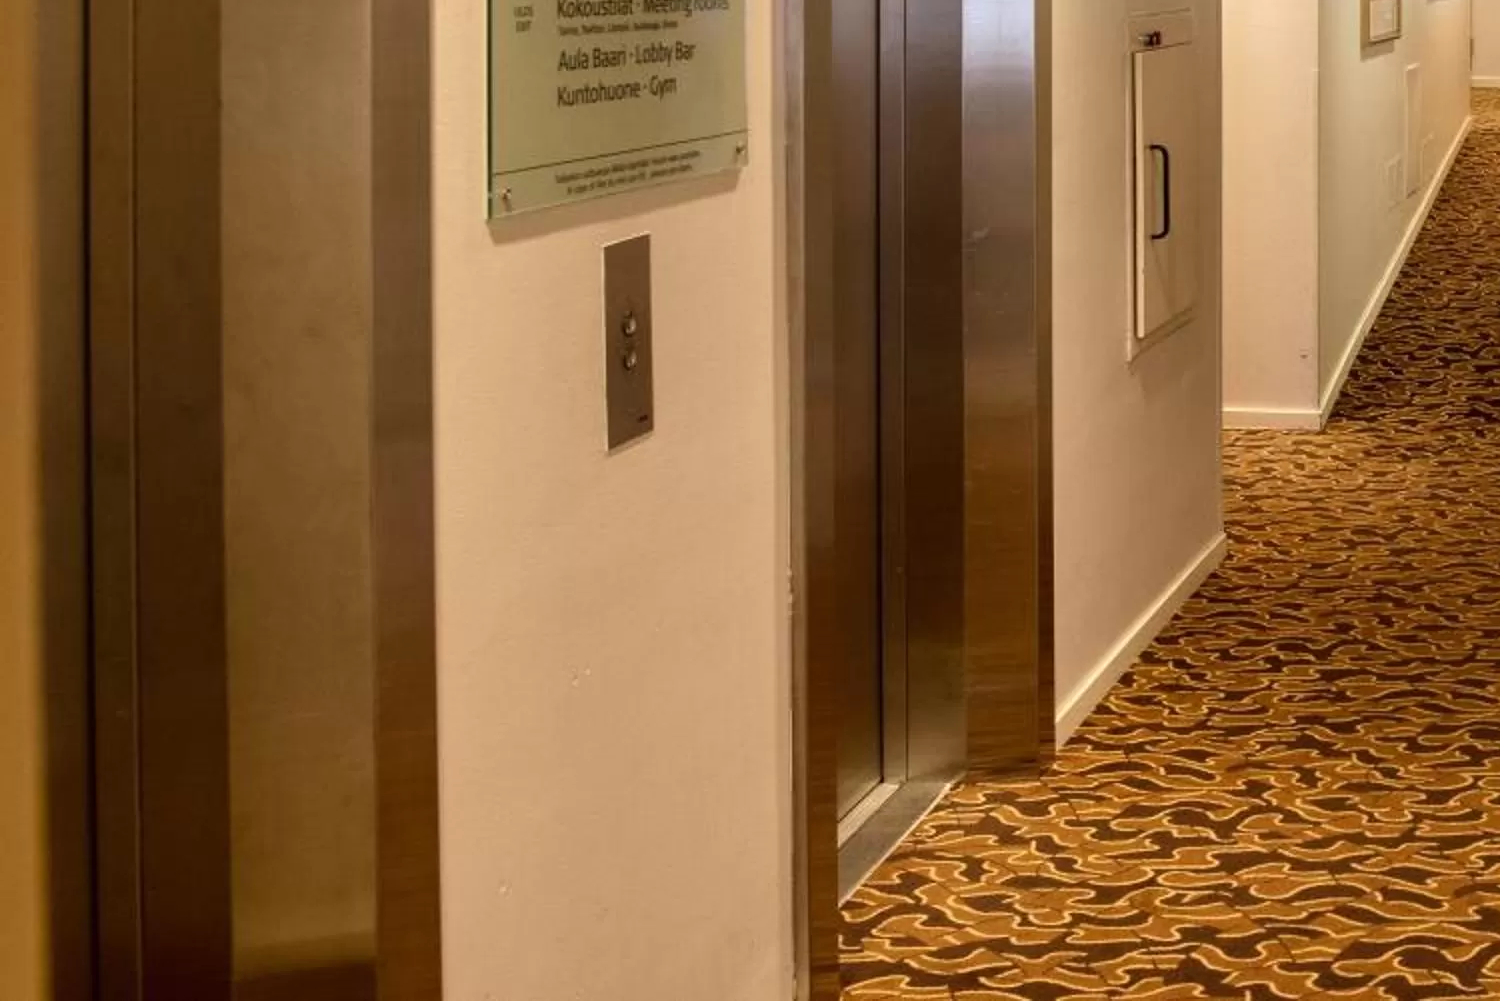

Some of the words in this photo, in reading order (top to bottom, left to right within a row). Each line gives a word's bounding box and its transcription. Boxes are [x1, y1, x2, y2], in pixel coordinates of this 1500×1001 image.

[557, 49, 589, 72] Aula
[592, 44, 626, 68] Baari
[634, 41, 673, 67] Lobby
[675, 39, 697, 61] Bar
[556, 78, 641, 107] Kuntohuone
[650, 74, 677, 99] Gym
